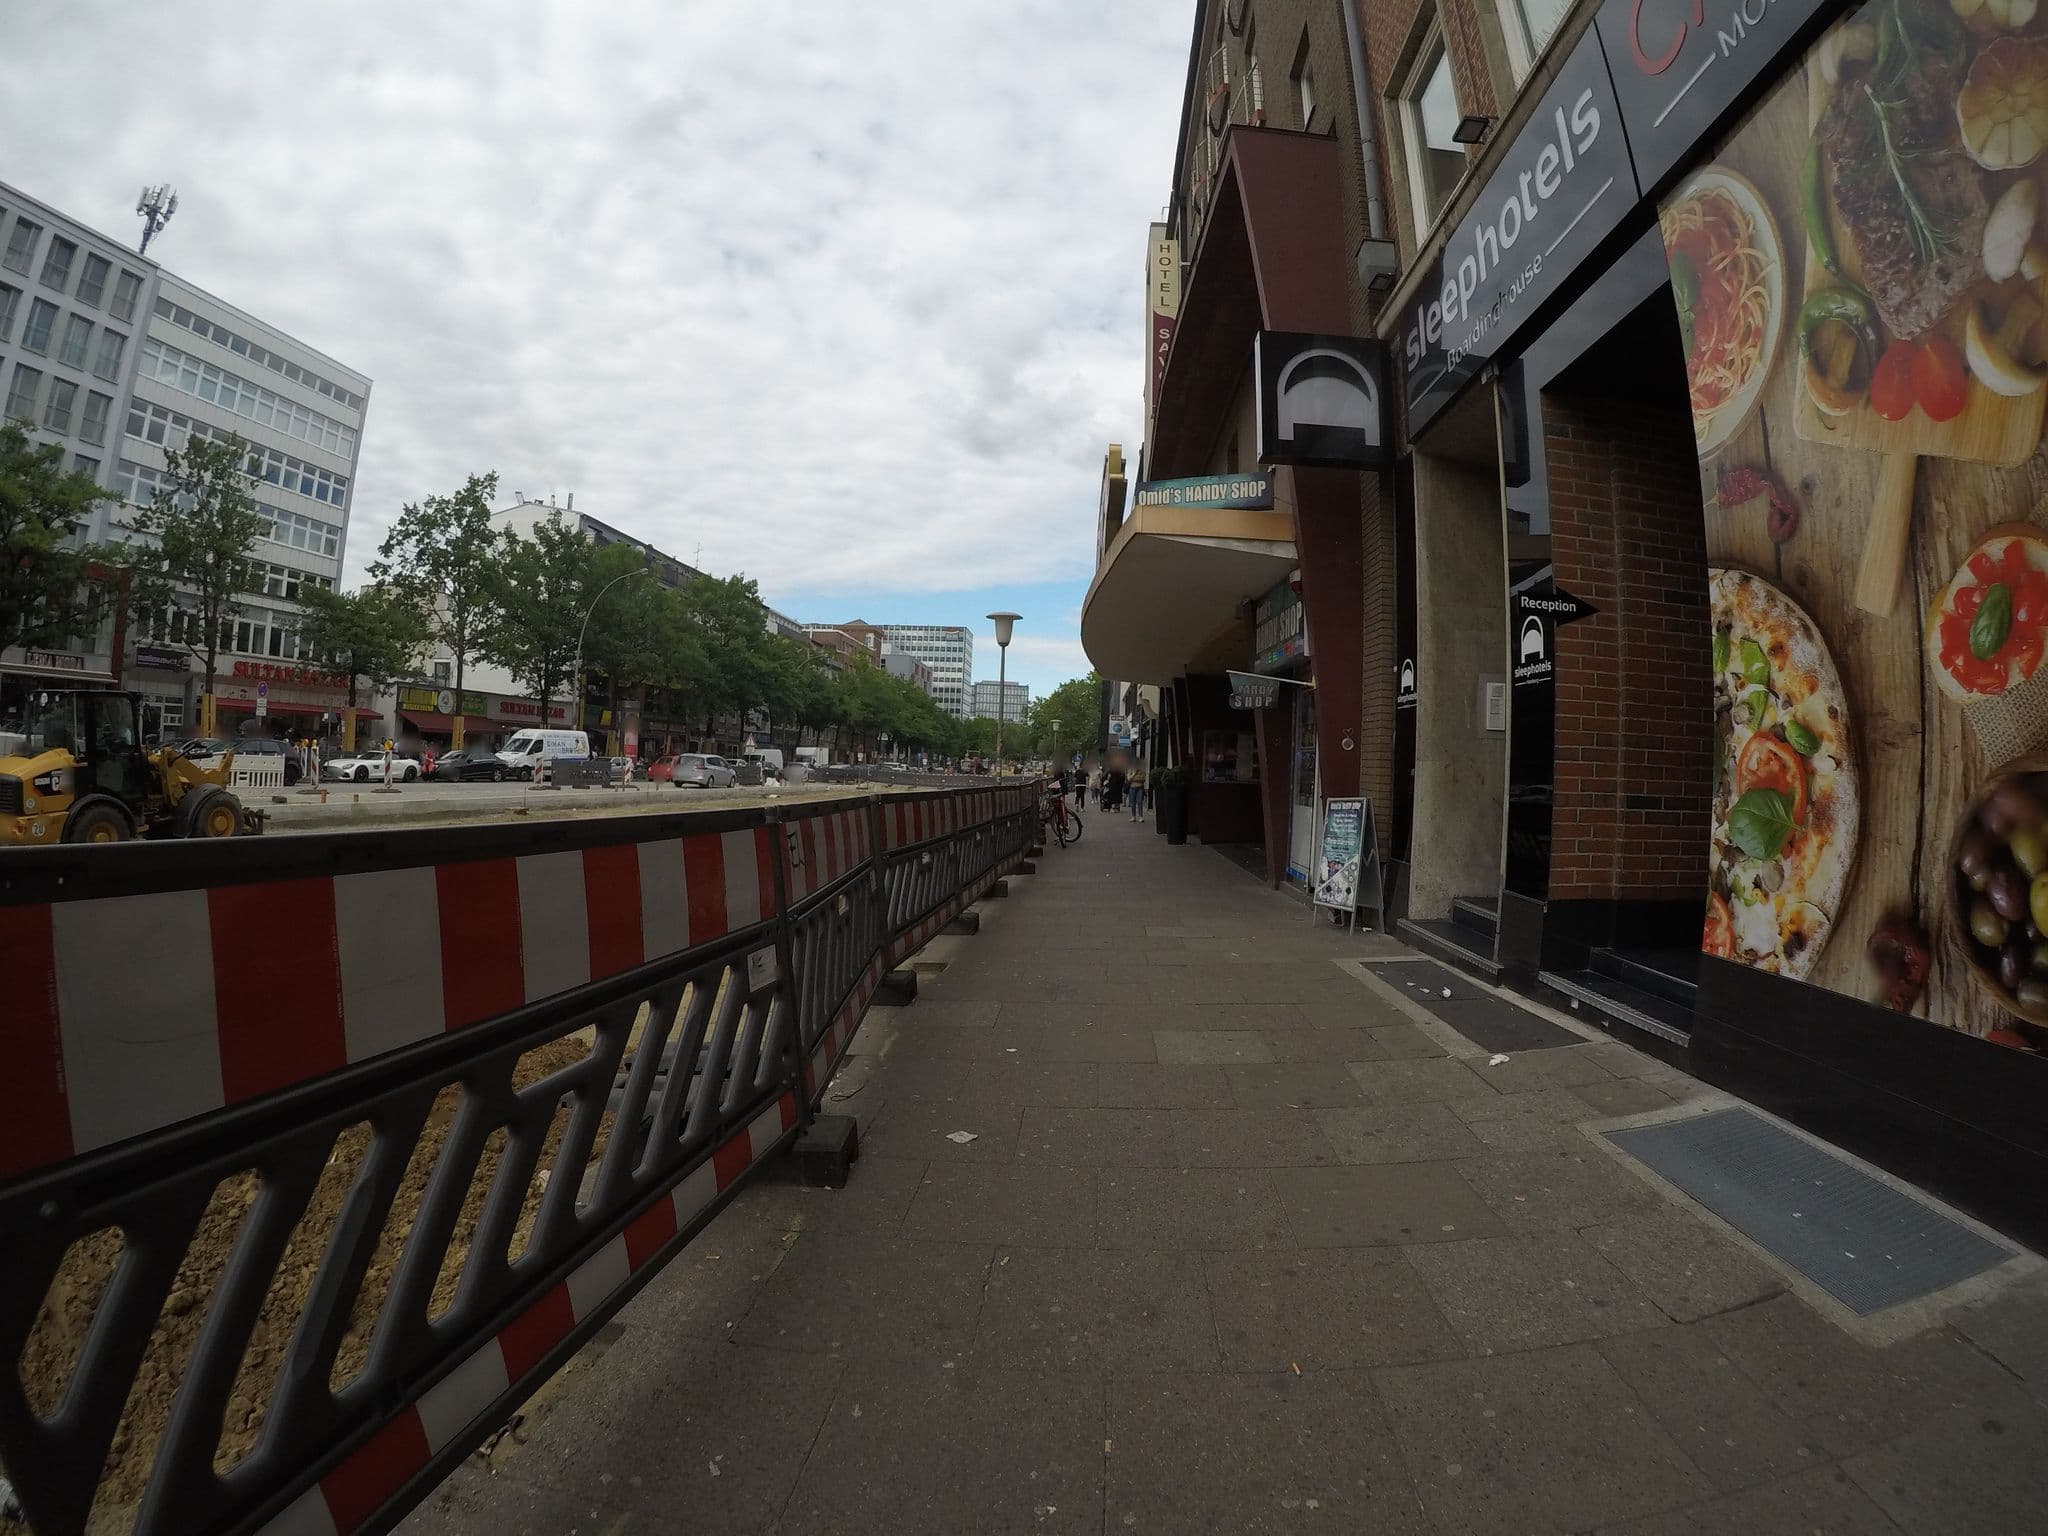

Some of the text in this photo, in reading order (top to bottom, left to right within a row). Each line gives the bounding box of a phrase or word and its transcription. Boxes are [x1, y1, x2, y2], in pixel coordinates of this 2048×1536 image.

[1717, 0, 1777, 58] MO
[1406, 87, 1601, 373] sleephotels
[1158, 244, 1171, 381] HOTEL SAV
[1185, 483, 1228, 502] HANDY
[1231, 480, 1267, 499] SHOP
[1520, 596, 1577, 613] Reception
[1279, 600, 1303, 641] SHOP
[233, 660, 294, 681] SULTAN
[1234, 695, 1273, 707] SHOP
